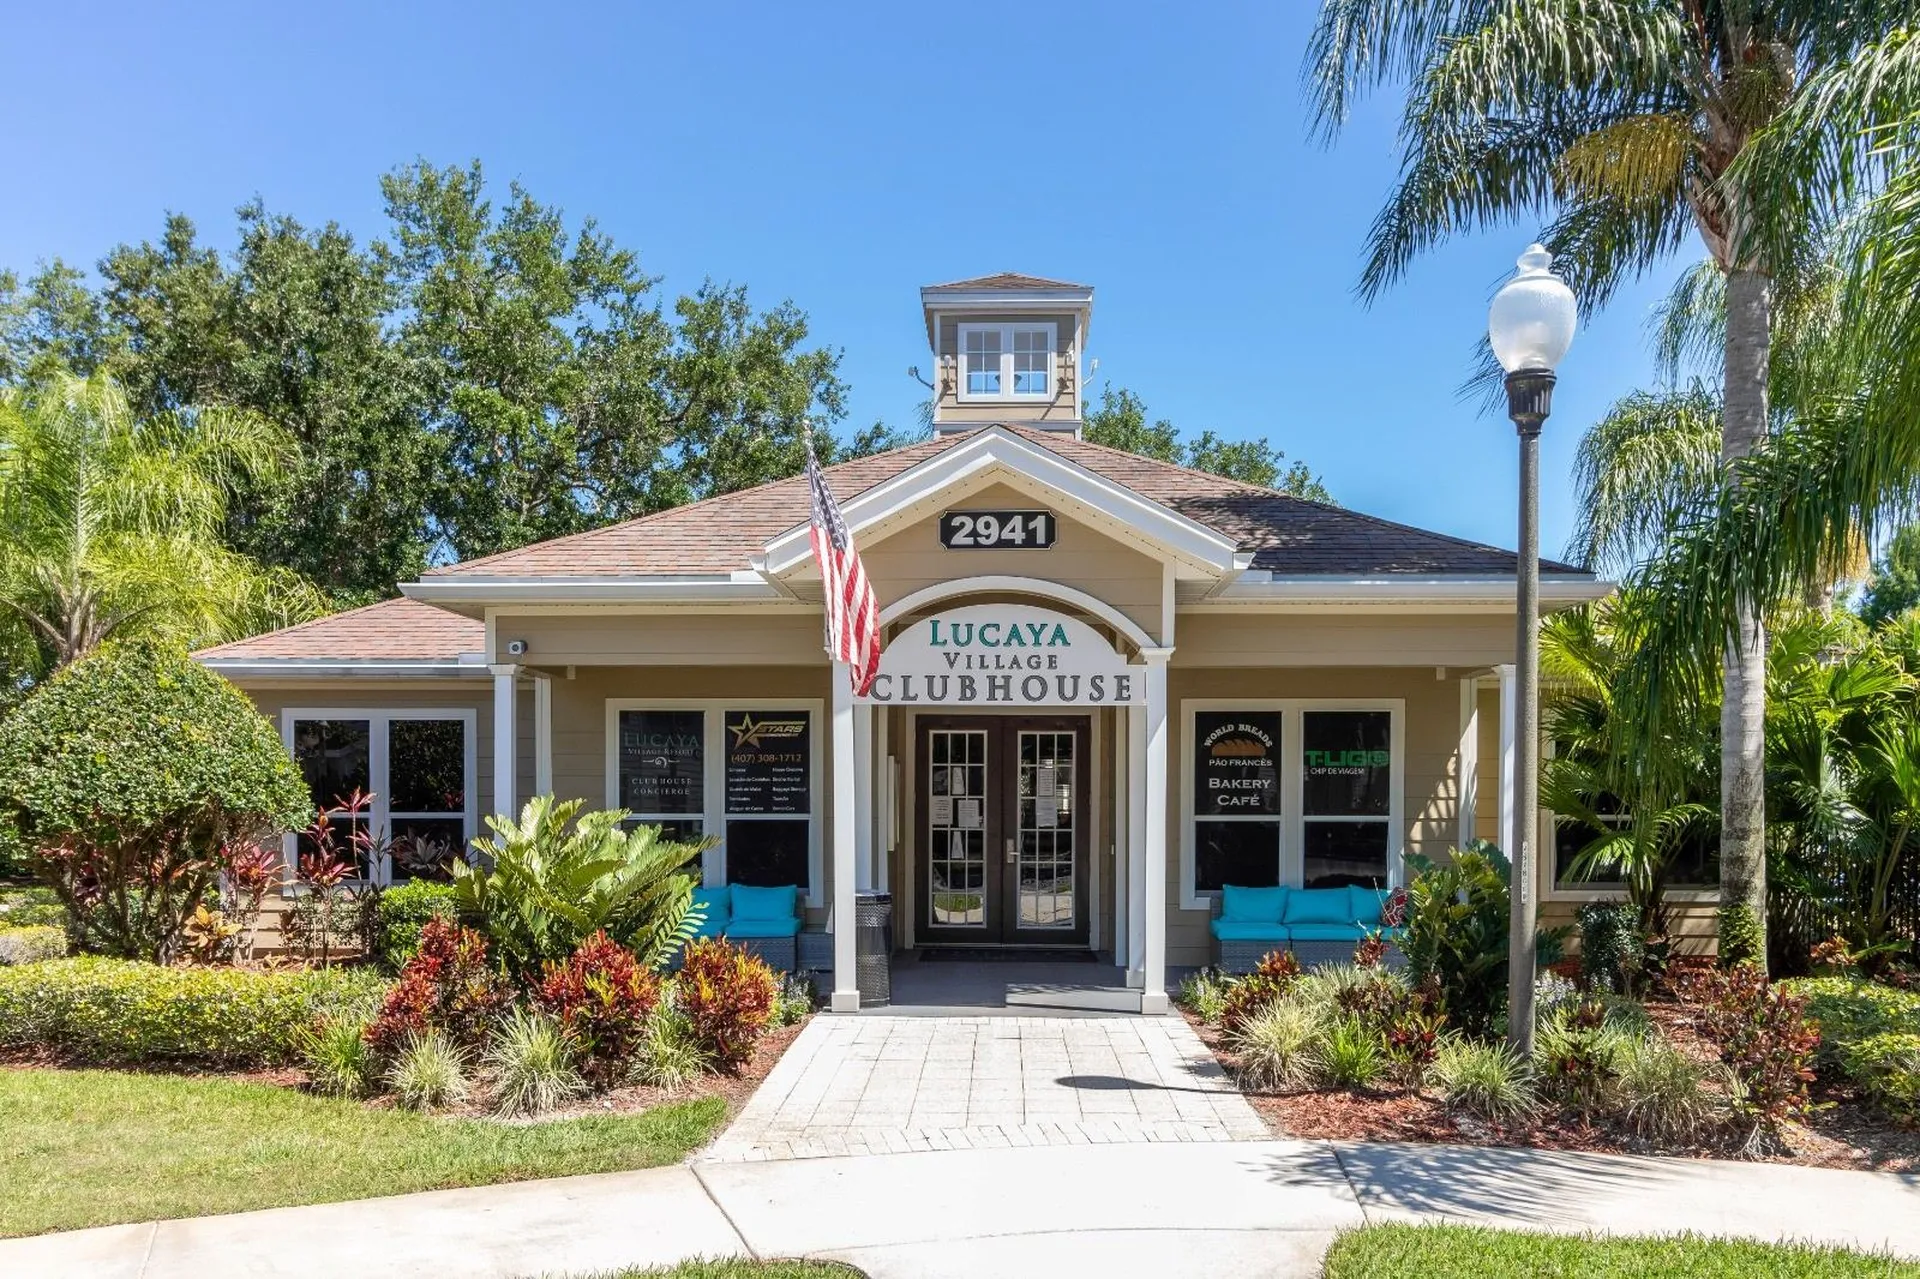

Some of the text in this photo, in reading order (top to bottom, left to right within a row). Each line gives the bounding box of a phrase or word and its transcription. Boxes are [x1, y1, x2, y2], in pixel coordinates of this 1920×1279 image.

[950, 515, 1047, 546] 2941
[930, 619, 1071, 648] LUCAYA
[942, 652, 1059, 670] VILLAGE
[869, 674, 1132, 702] CLUBHOUSE
[757, 725, 804, 733] STARS
[1204, 723, 1273, 748] WORLD BREADS
[623, 731, 699, 747] LUCAYA
[731, 753, 802, 764] (407) 308-1712
[1310, 767, 1364, 775] CHIP DE VIAGEM
[1208, 777, 1272, 789] BAKERY
[633, 787, 691, 796] CONCIERGE
[1217, 793, 1260, 806] CAFÉ
